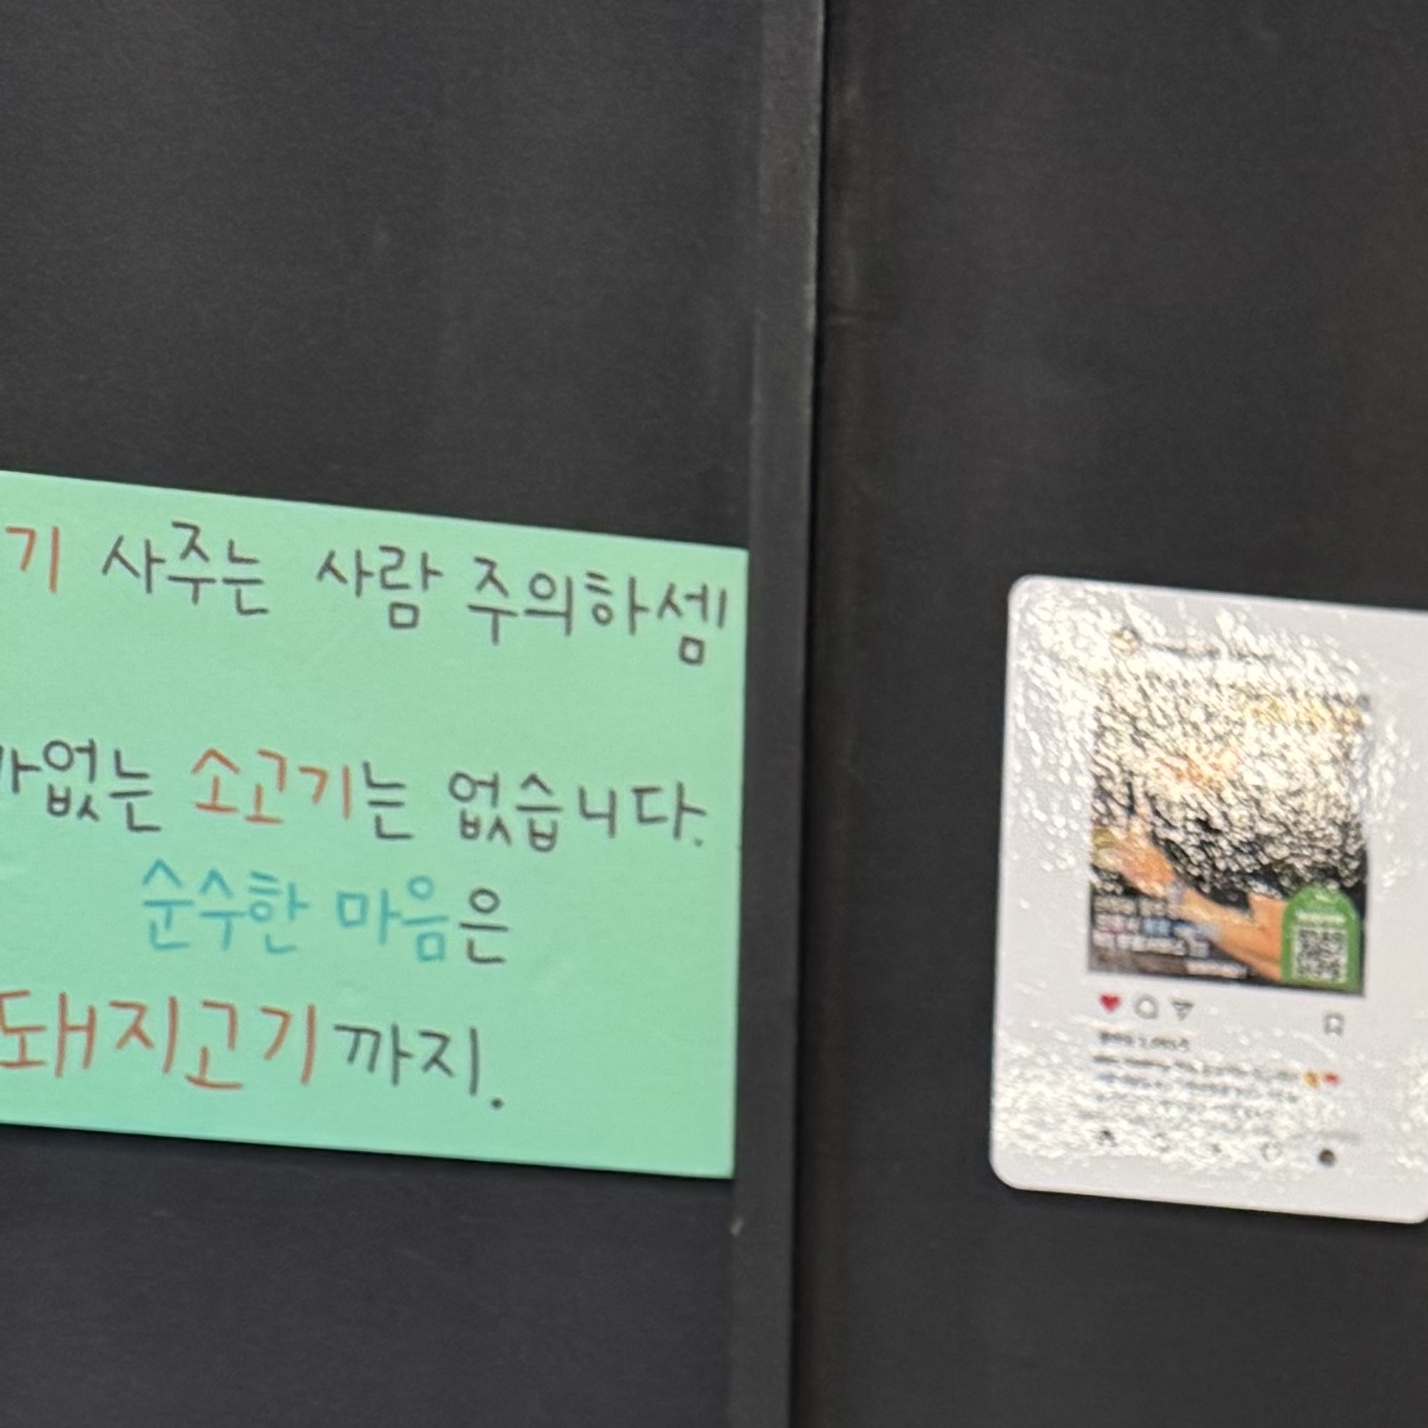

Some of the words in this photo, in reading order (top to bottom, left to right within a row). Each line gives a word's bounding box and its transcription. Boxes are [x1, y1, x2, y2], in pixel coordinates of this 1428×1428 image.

[6, 526, 60, 592] 기
[101, 521, 270, 616] 사주는
[316, 545, 443, 630] 사람
[466, 556, 727, 666] 주의하셈
[192, 748, 415, 842] 소고기는
[447, 771, 707, 854] 없습니다.
[141, 858, 310, 956] 순수한
[335, 875, 509, 965] 마음은
[0, 990, 504, 1111] 돼지고기까지.
